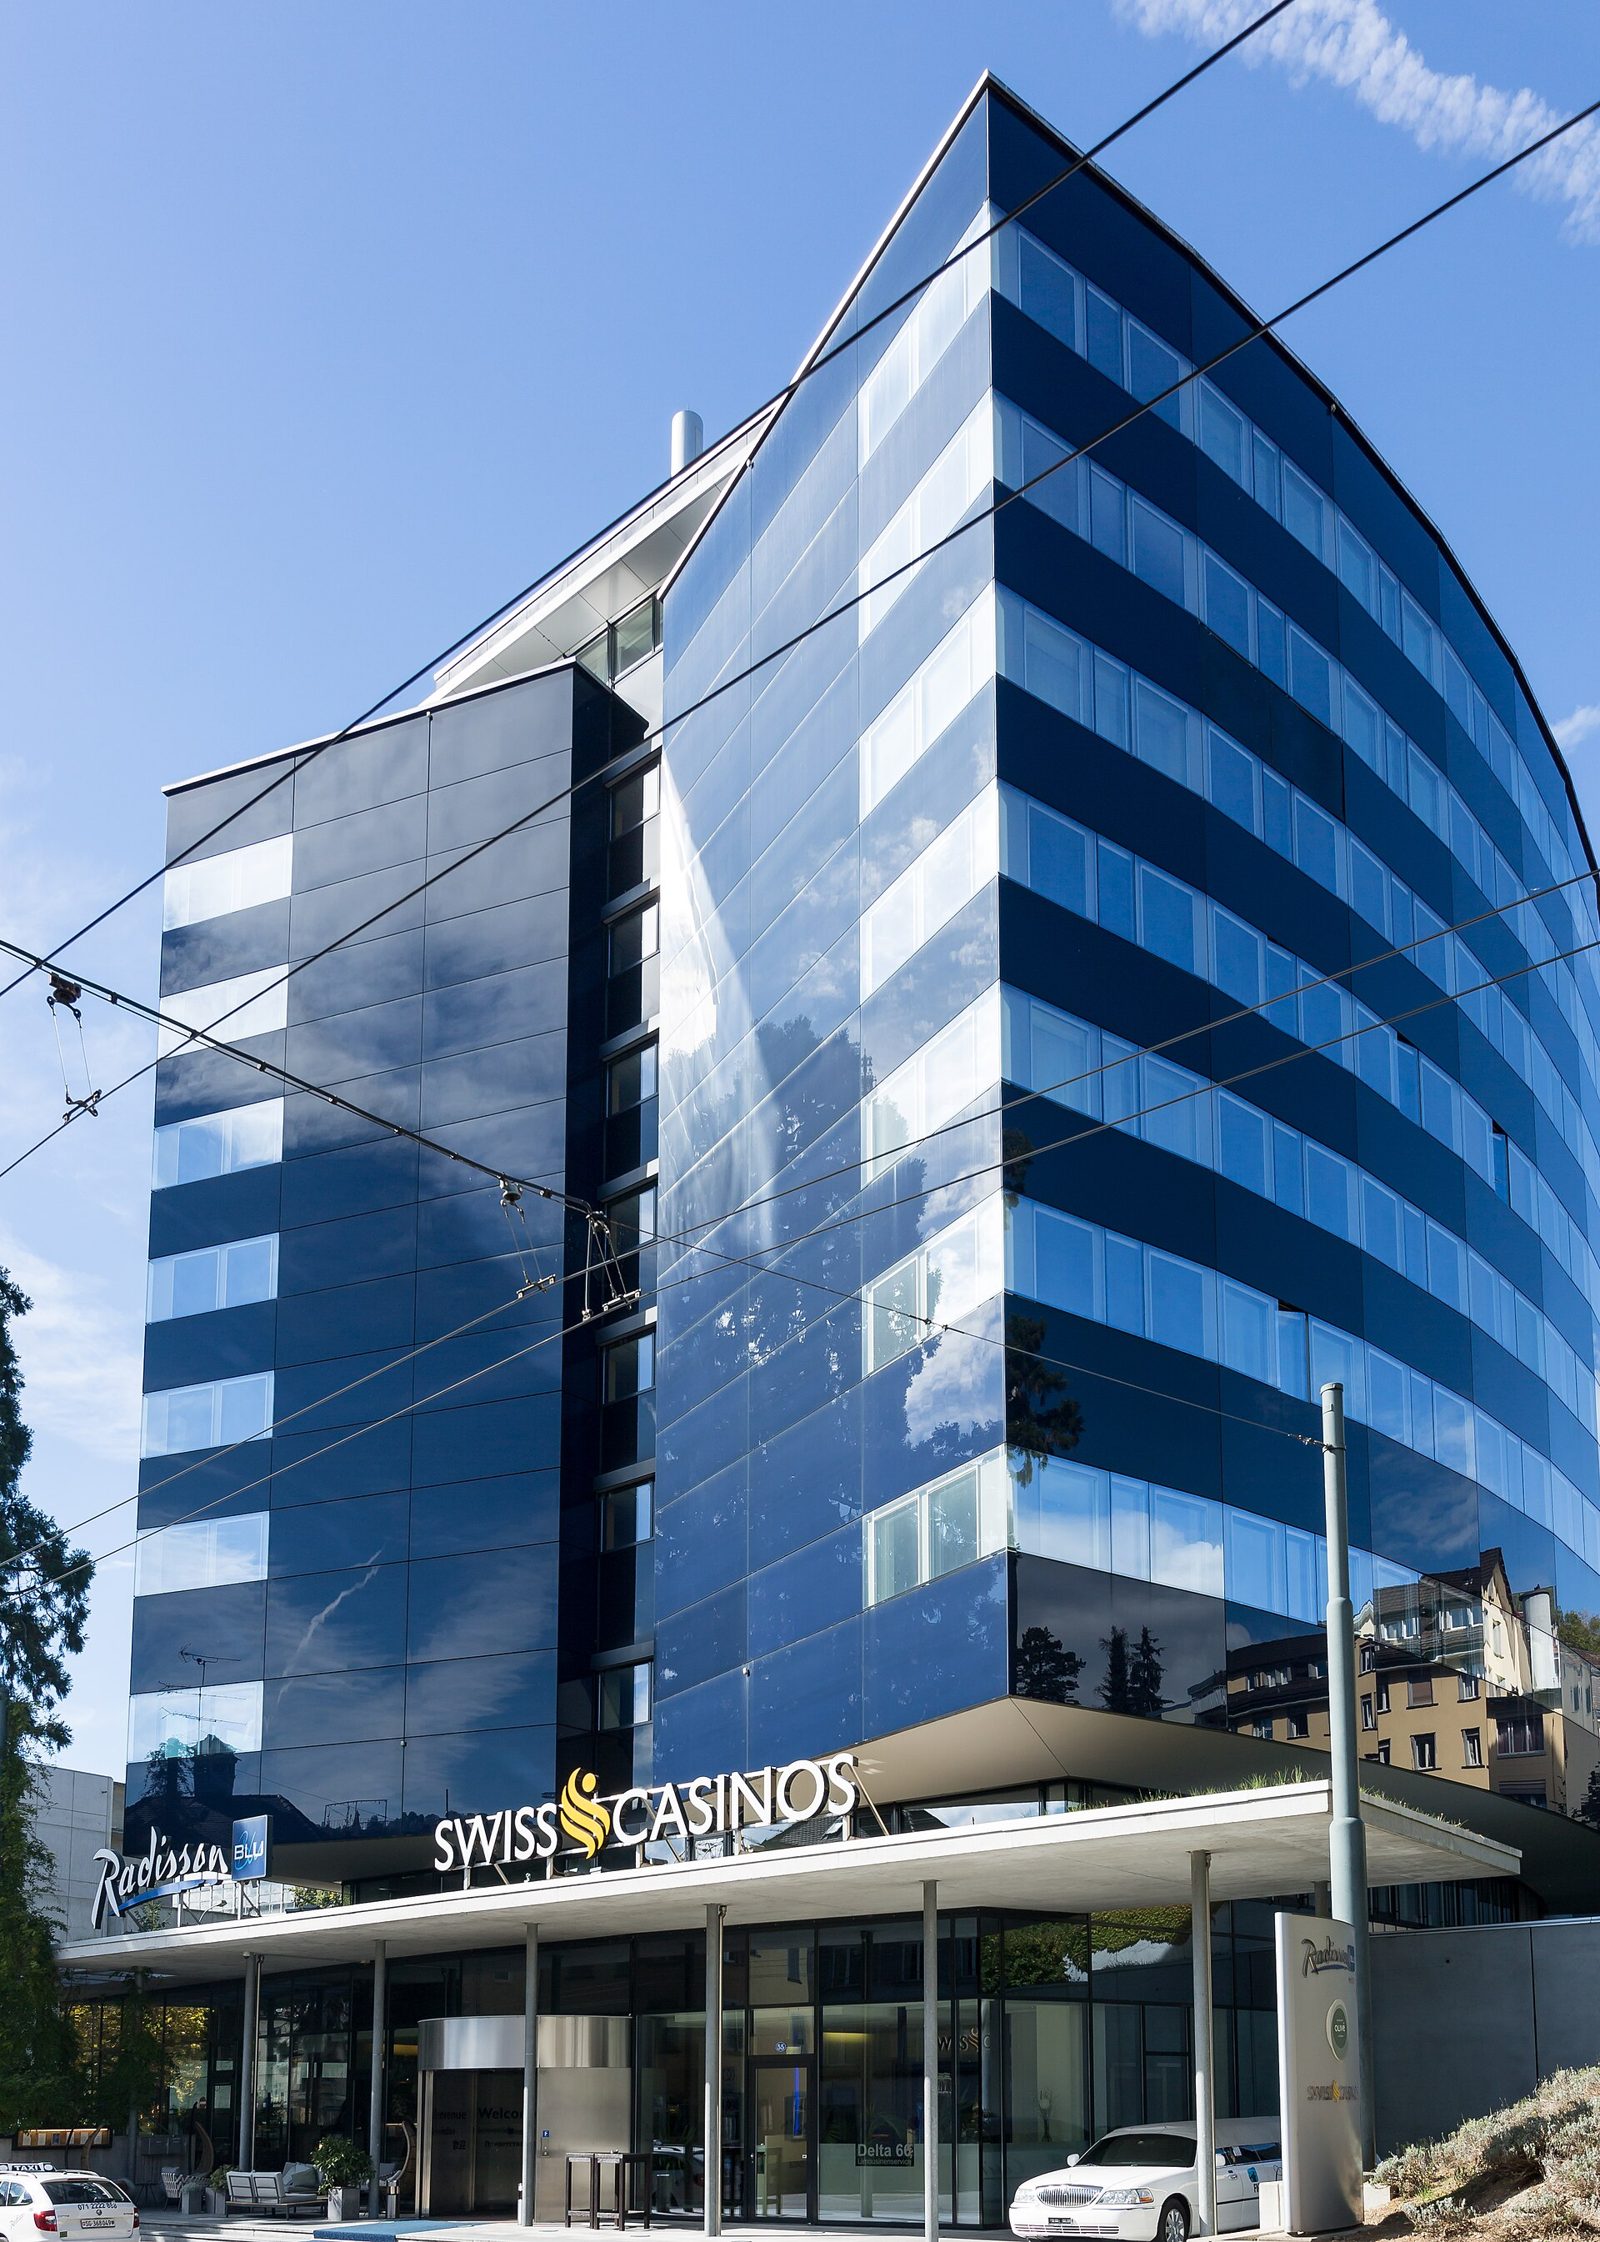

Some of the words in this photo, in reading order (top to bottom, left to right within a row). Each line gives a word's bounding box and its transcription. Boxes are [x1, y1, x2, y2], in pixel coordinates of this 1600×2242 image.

[434, 1803, 558, 1872] SWISS
[612, 1753, 856, 1846] CASINOS
[91, 1826, 229, 1929] Radisson
[478, 2106, 523, 2119] Welco
[857, 2143, 892, 2157] Delta
[896, 2143, 913, 2157] 66
